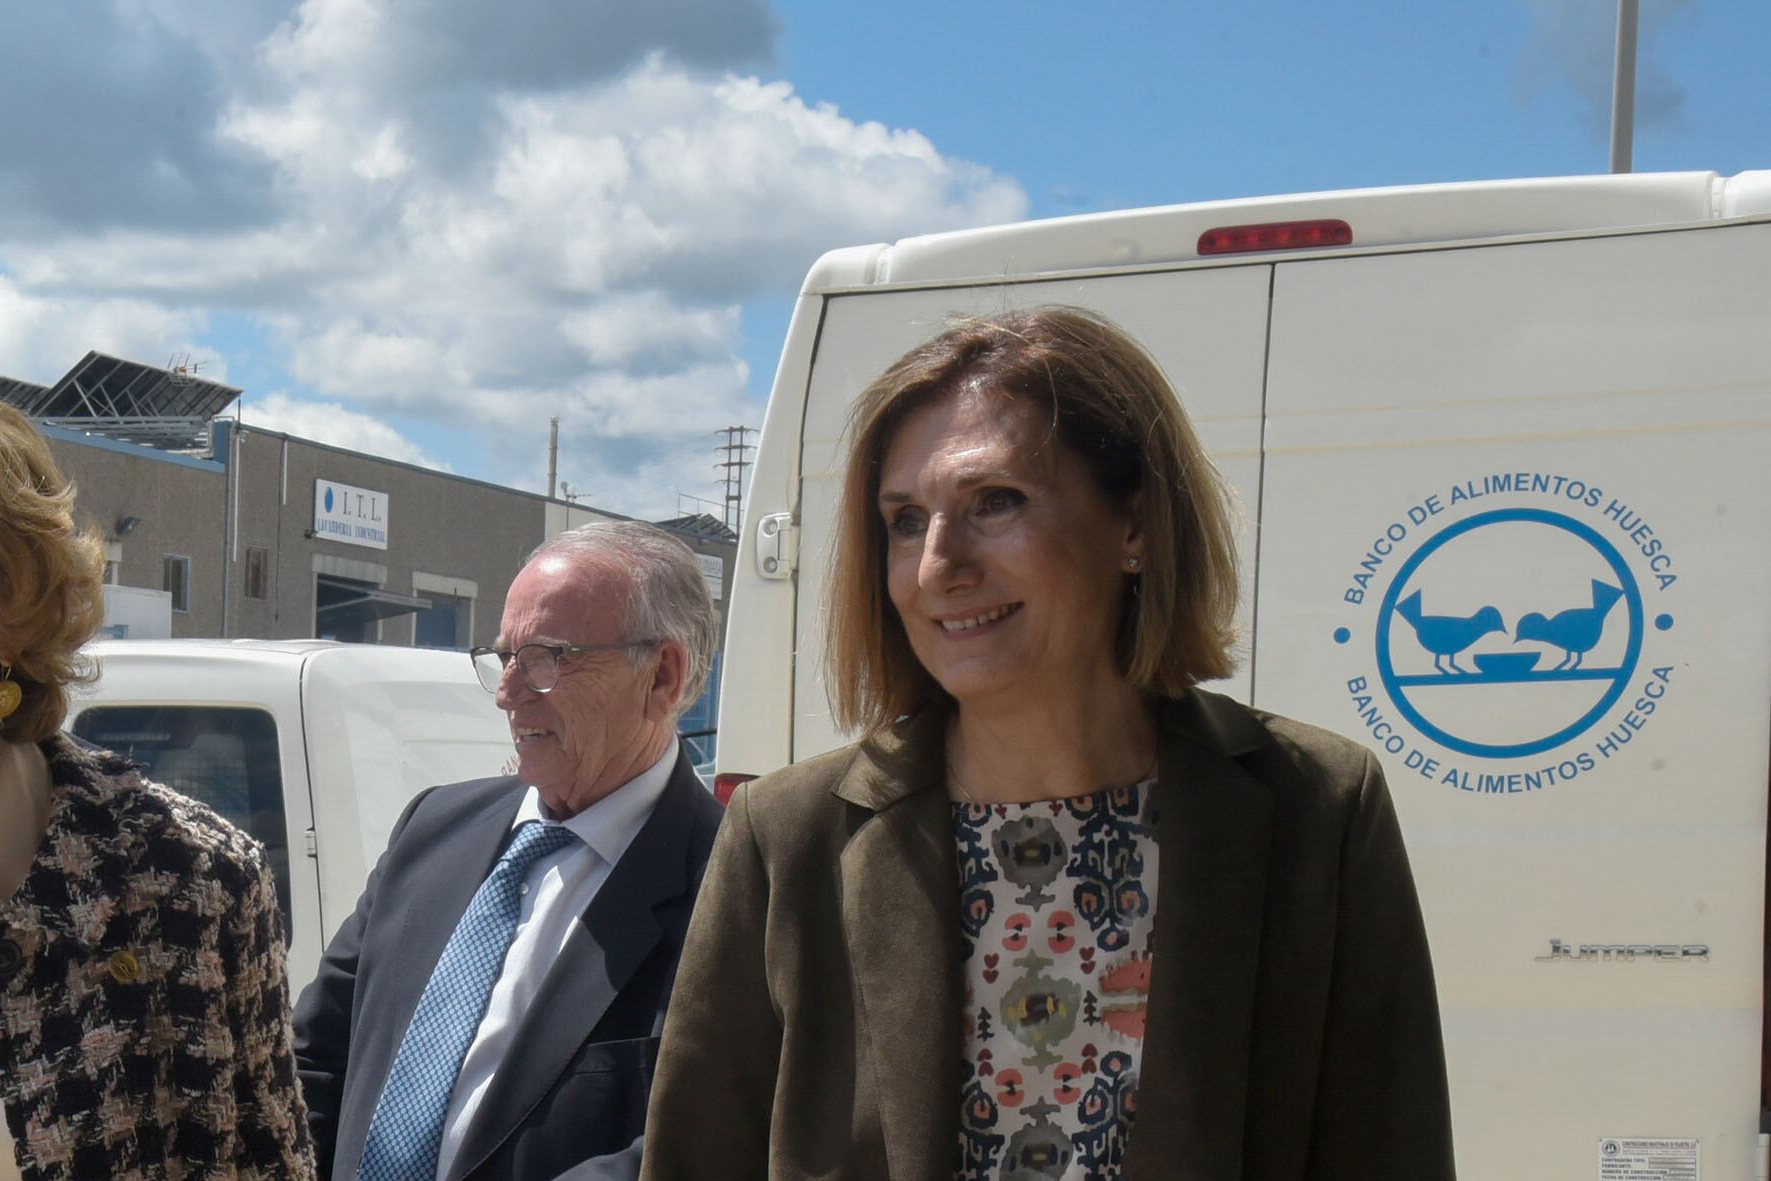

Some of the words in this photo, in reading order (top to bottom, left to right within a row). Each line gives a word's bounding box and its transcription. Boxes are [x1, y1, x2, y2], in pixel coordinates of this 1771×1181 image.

[1343, 522, 1407, 605] BANCO
[1406, 494, 1445, 527] DE
[1450, 472, 1604, 508] ALIMENTOS
[1603, 499, 1678, 592] HUESCA
[1346, 675, 1405, 754] BANCO
[1403, 749, 1440, 780] DE
[1441, 752, 1596, 794] ALIMENTOS
[1595, 665, 1675, 758] HUESCA
